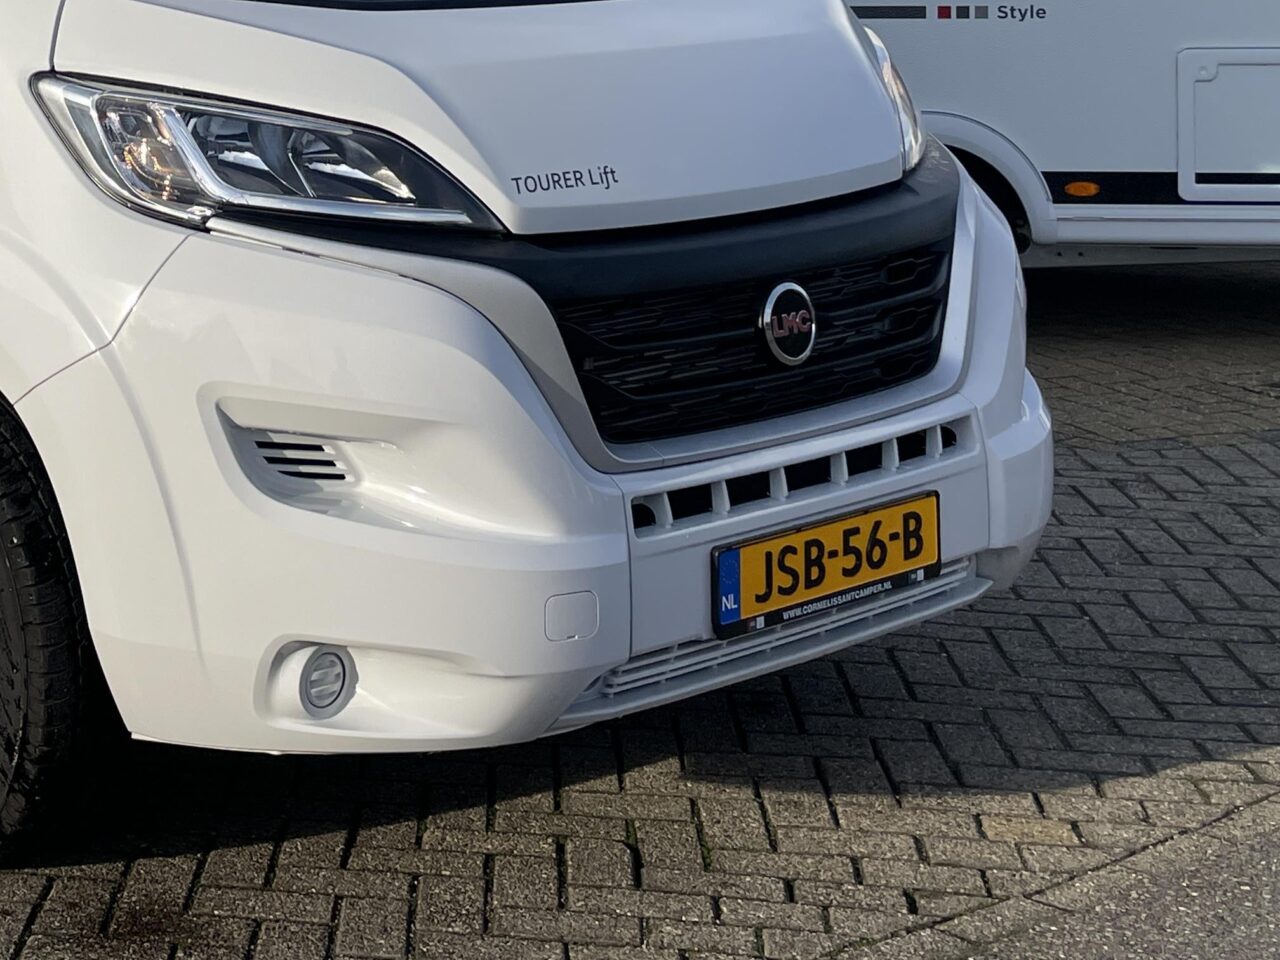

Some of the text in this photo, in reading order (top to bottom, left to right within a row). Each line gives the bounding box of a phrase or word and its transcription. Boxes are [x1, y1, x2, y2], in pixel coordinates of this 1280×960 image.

[997, 4, 1047, 22] Style
[511, 165, 619, 195] TOURER Lift
[772, 310, 811, 338] LMC
[755, 511, 924, 603] JSB-56-B
[721, 593, 738, 611] NL
